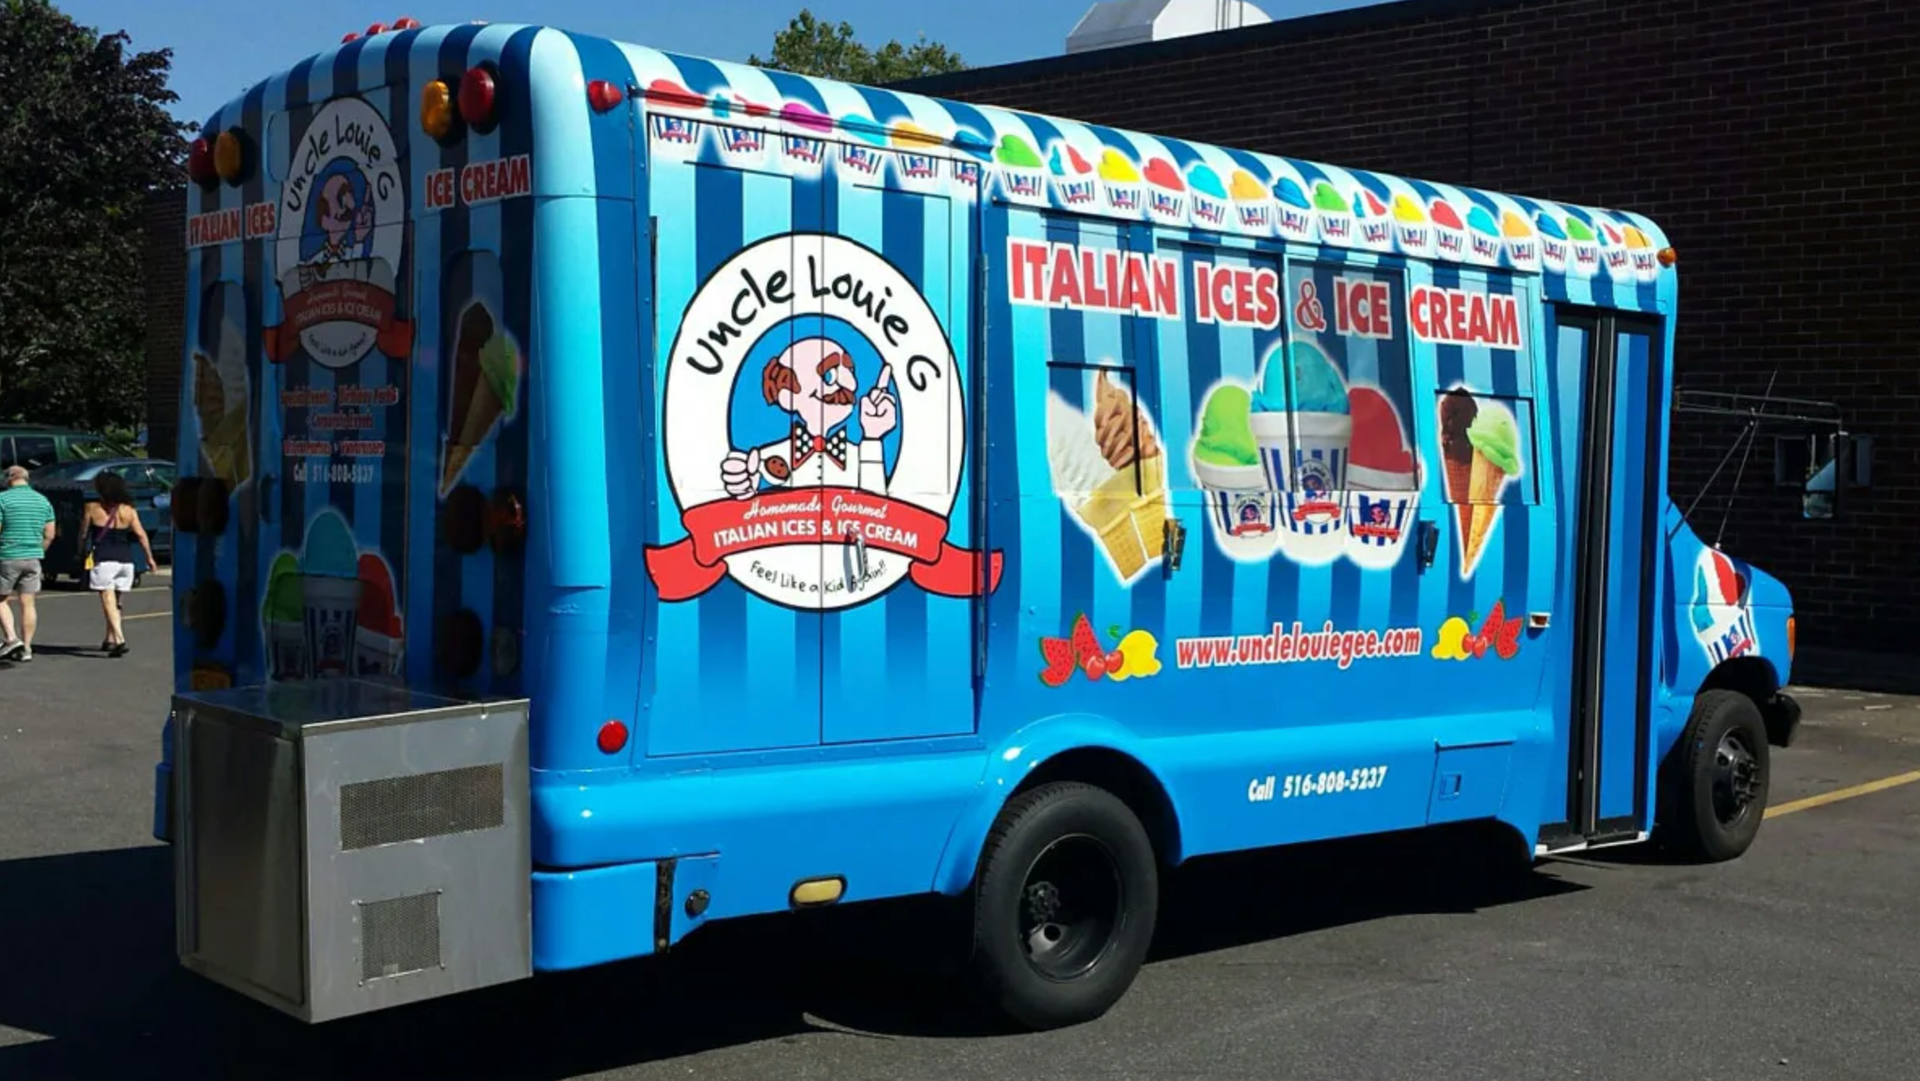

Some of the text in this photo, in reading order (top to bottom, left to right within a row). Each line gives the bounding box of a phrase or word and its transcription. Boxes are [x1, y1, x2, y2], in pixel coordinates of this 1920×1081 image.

[287, 113, 395, 212] Uncle Louie G
[425, 155, 530, 208] ICE CREAM
[189, 201, 276, 246] ITALIAN ICES
[1010, 242, 1521, 347] ITALIAN ICES & ICE CREAM
[686, 254, 942, 392] Uncle Louie G
[743, 494, 888, 519] Homemade Gourmet
[713, 520, 778, 548] ITALIAN
[781, 519, 817, 536] ICES
[821, 519, 834, 536] &
[864, 521, 919, 549] CREAM
[749, 559, 778, 584] Feel
[780, 573, 807, 593] Like
[808, 583, 820, 593] a
[824, 580, 845, 595] Kid
[1177, 622, 1421, 668] www.unclelouiegee.com
[1247, 765, 1389, 802] Call 516-808-5237
